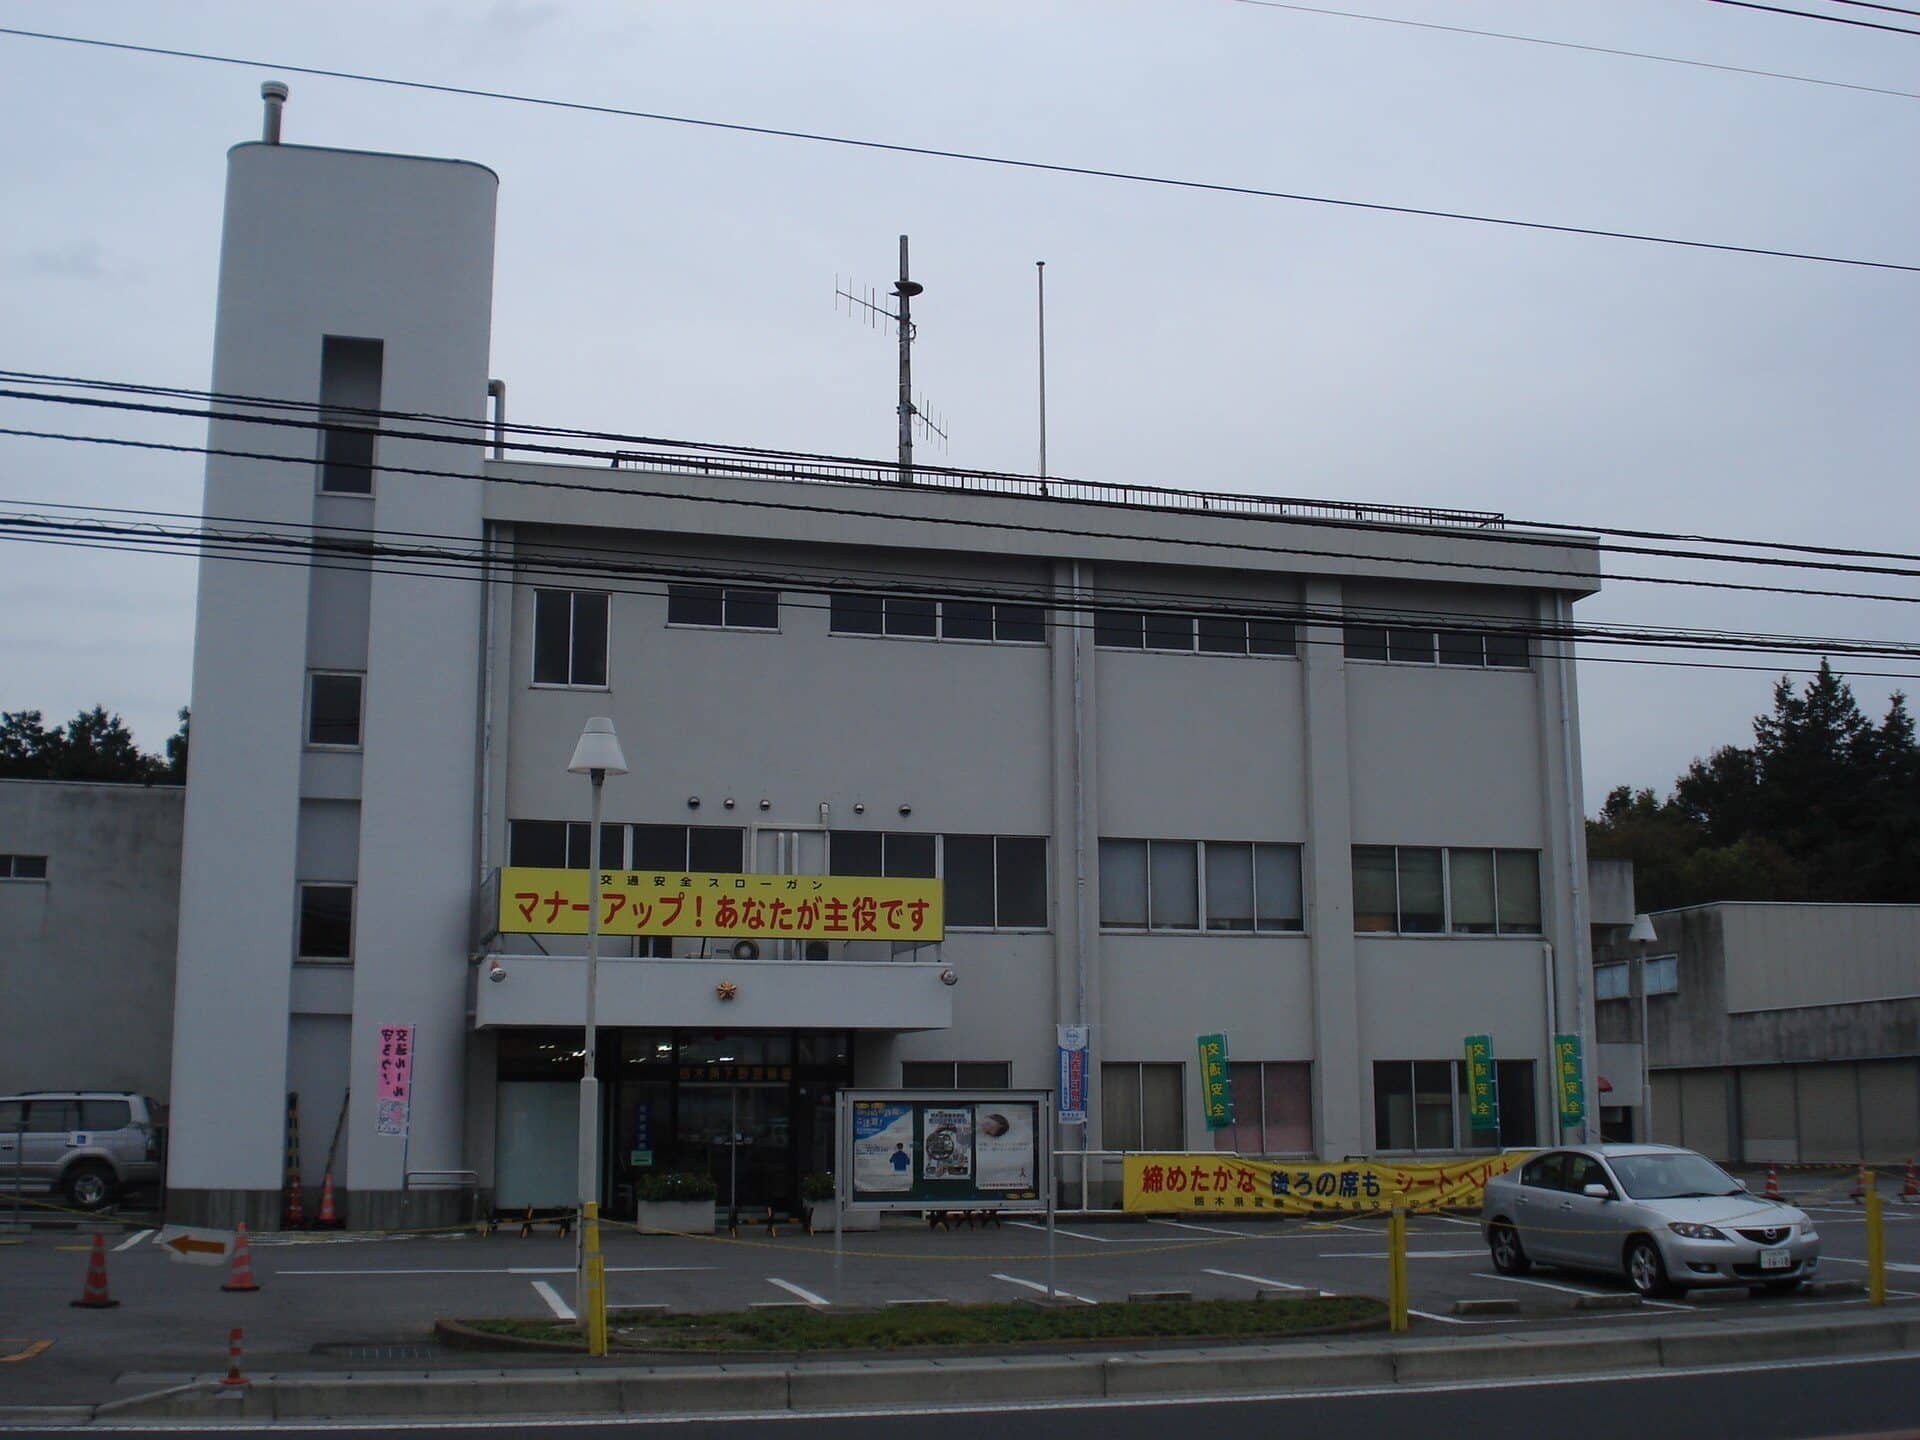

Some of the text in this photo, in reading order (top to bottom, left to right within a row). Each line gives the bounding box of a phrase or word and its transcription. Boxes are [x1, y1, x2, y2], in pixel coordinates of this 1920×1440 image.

[600, 874, 823, 891] 交通安全スローガン
[1142, 1165, 1256, 1194] 締めたかな
[1270, 1170, 1381, 1198] 後ろの席も
